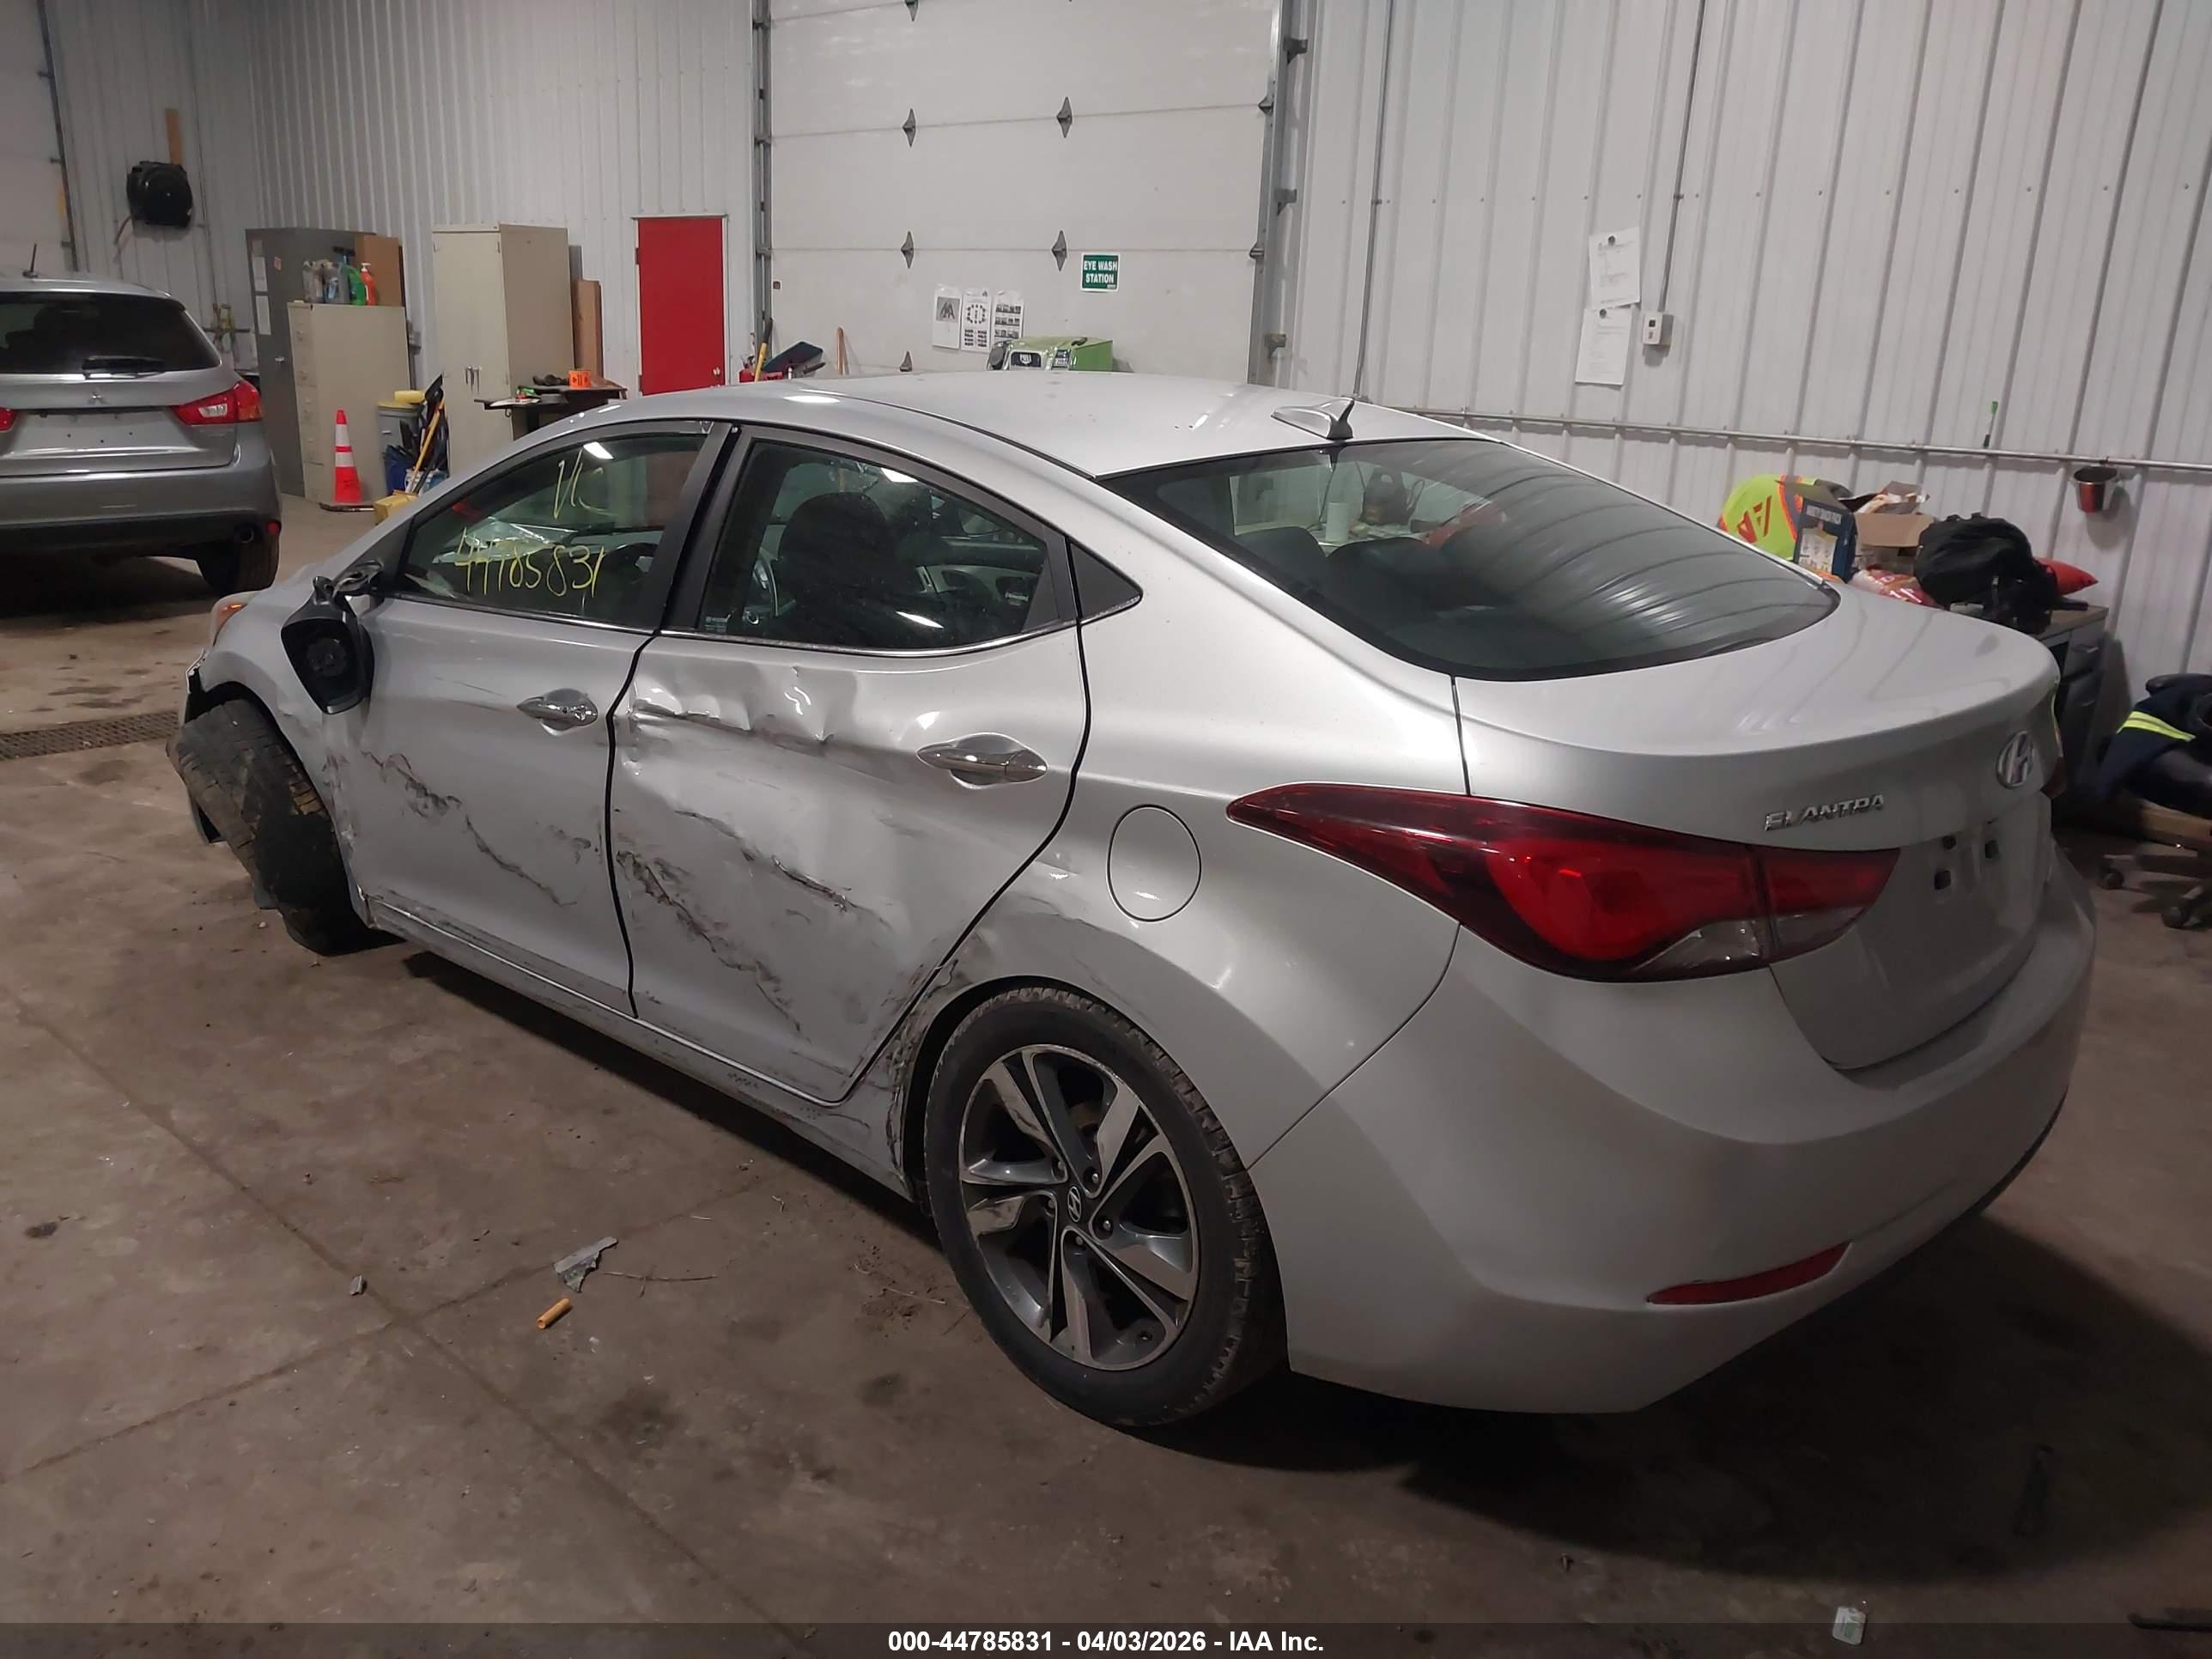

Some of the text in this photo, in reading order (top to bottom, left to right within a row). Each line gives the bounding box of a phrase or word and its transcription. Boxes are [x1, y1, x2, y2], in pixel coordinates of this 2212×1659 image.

[1084, 260, 1118, 271] EYE WASH
[1085, 273, 1115, 284] STATION
